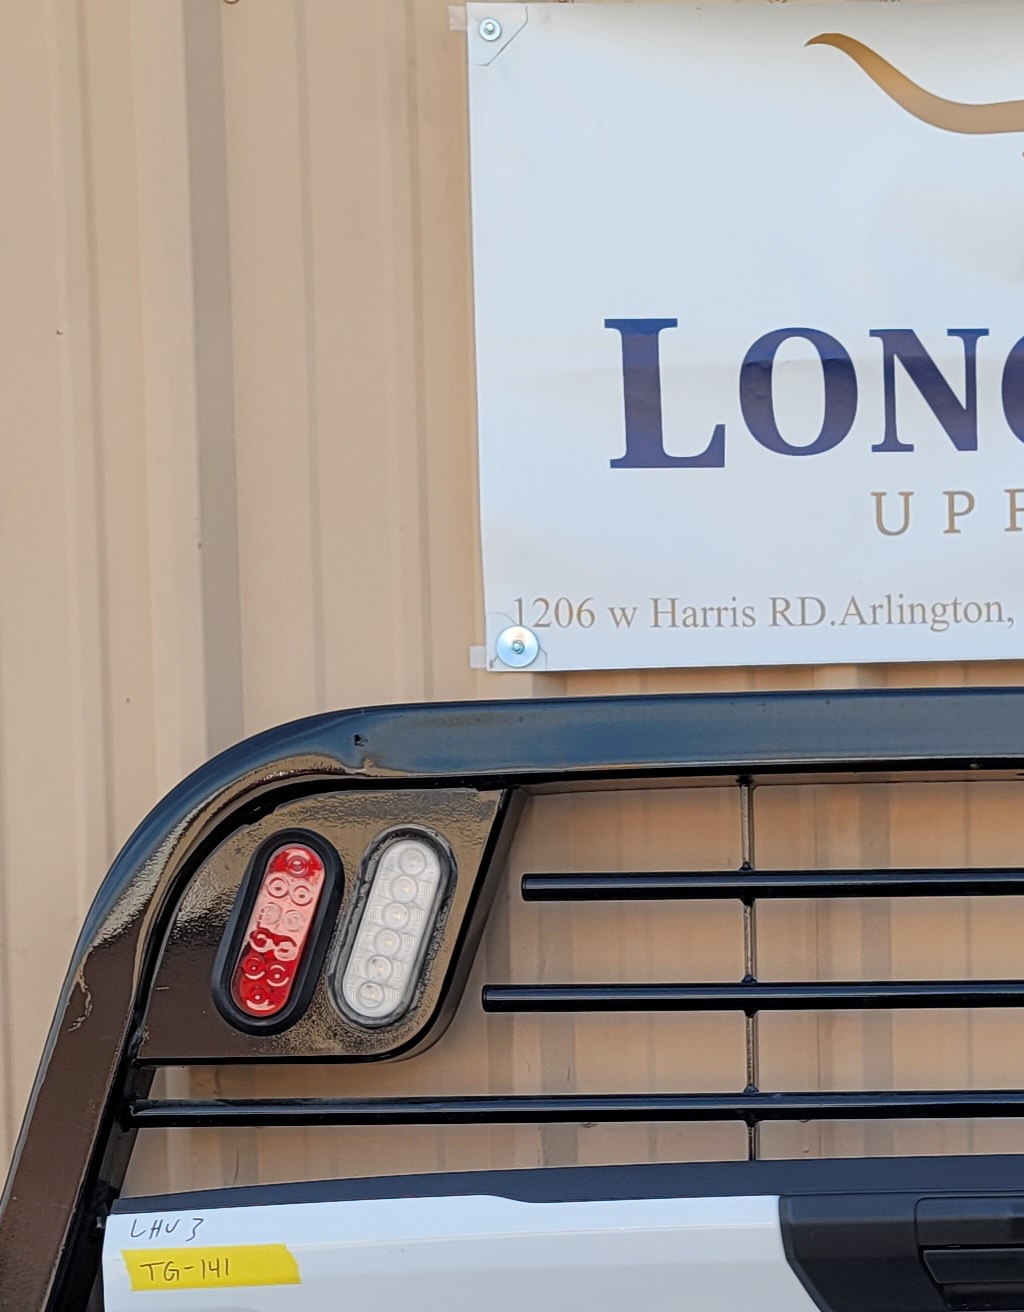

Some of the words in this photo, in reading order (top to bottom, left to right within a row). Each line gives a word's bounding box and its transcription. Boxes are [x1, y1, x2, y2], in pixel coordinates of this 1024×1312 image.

[513, 596, 596, 629] 1206
[607, 606, 638, 629] w
[649, 595, 756, 629] Harris
[139, 1257, 230, 1282] TG-141
